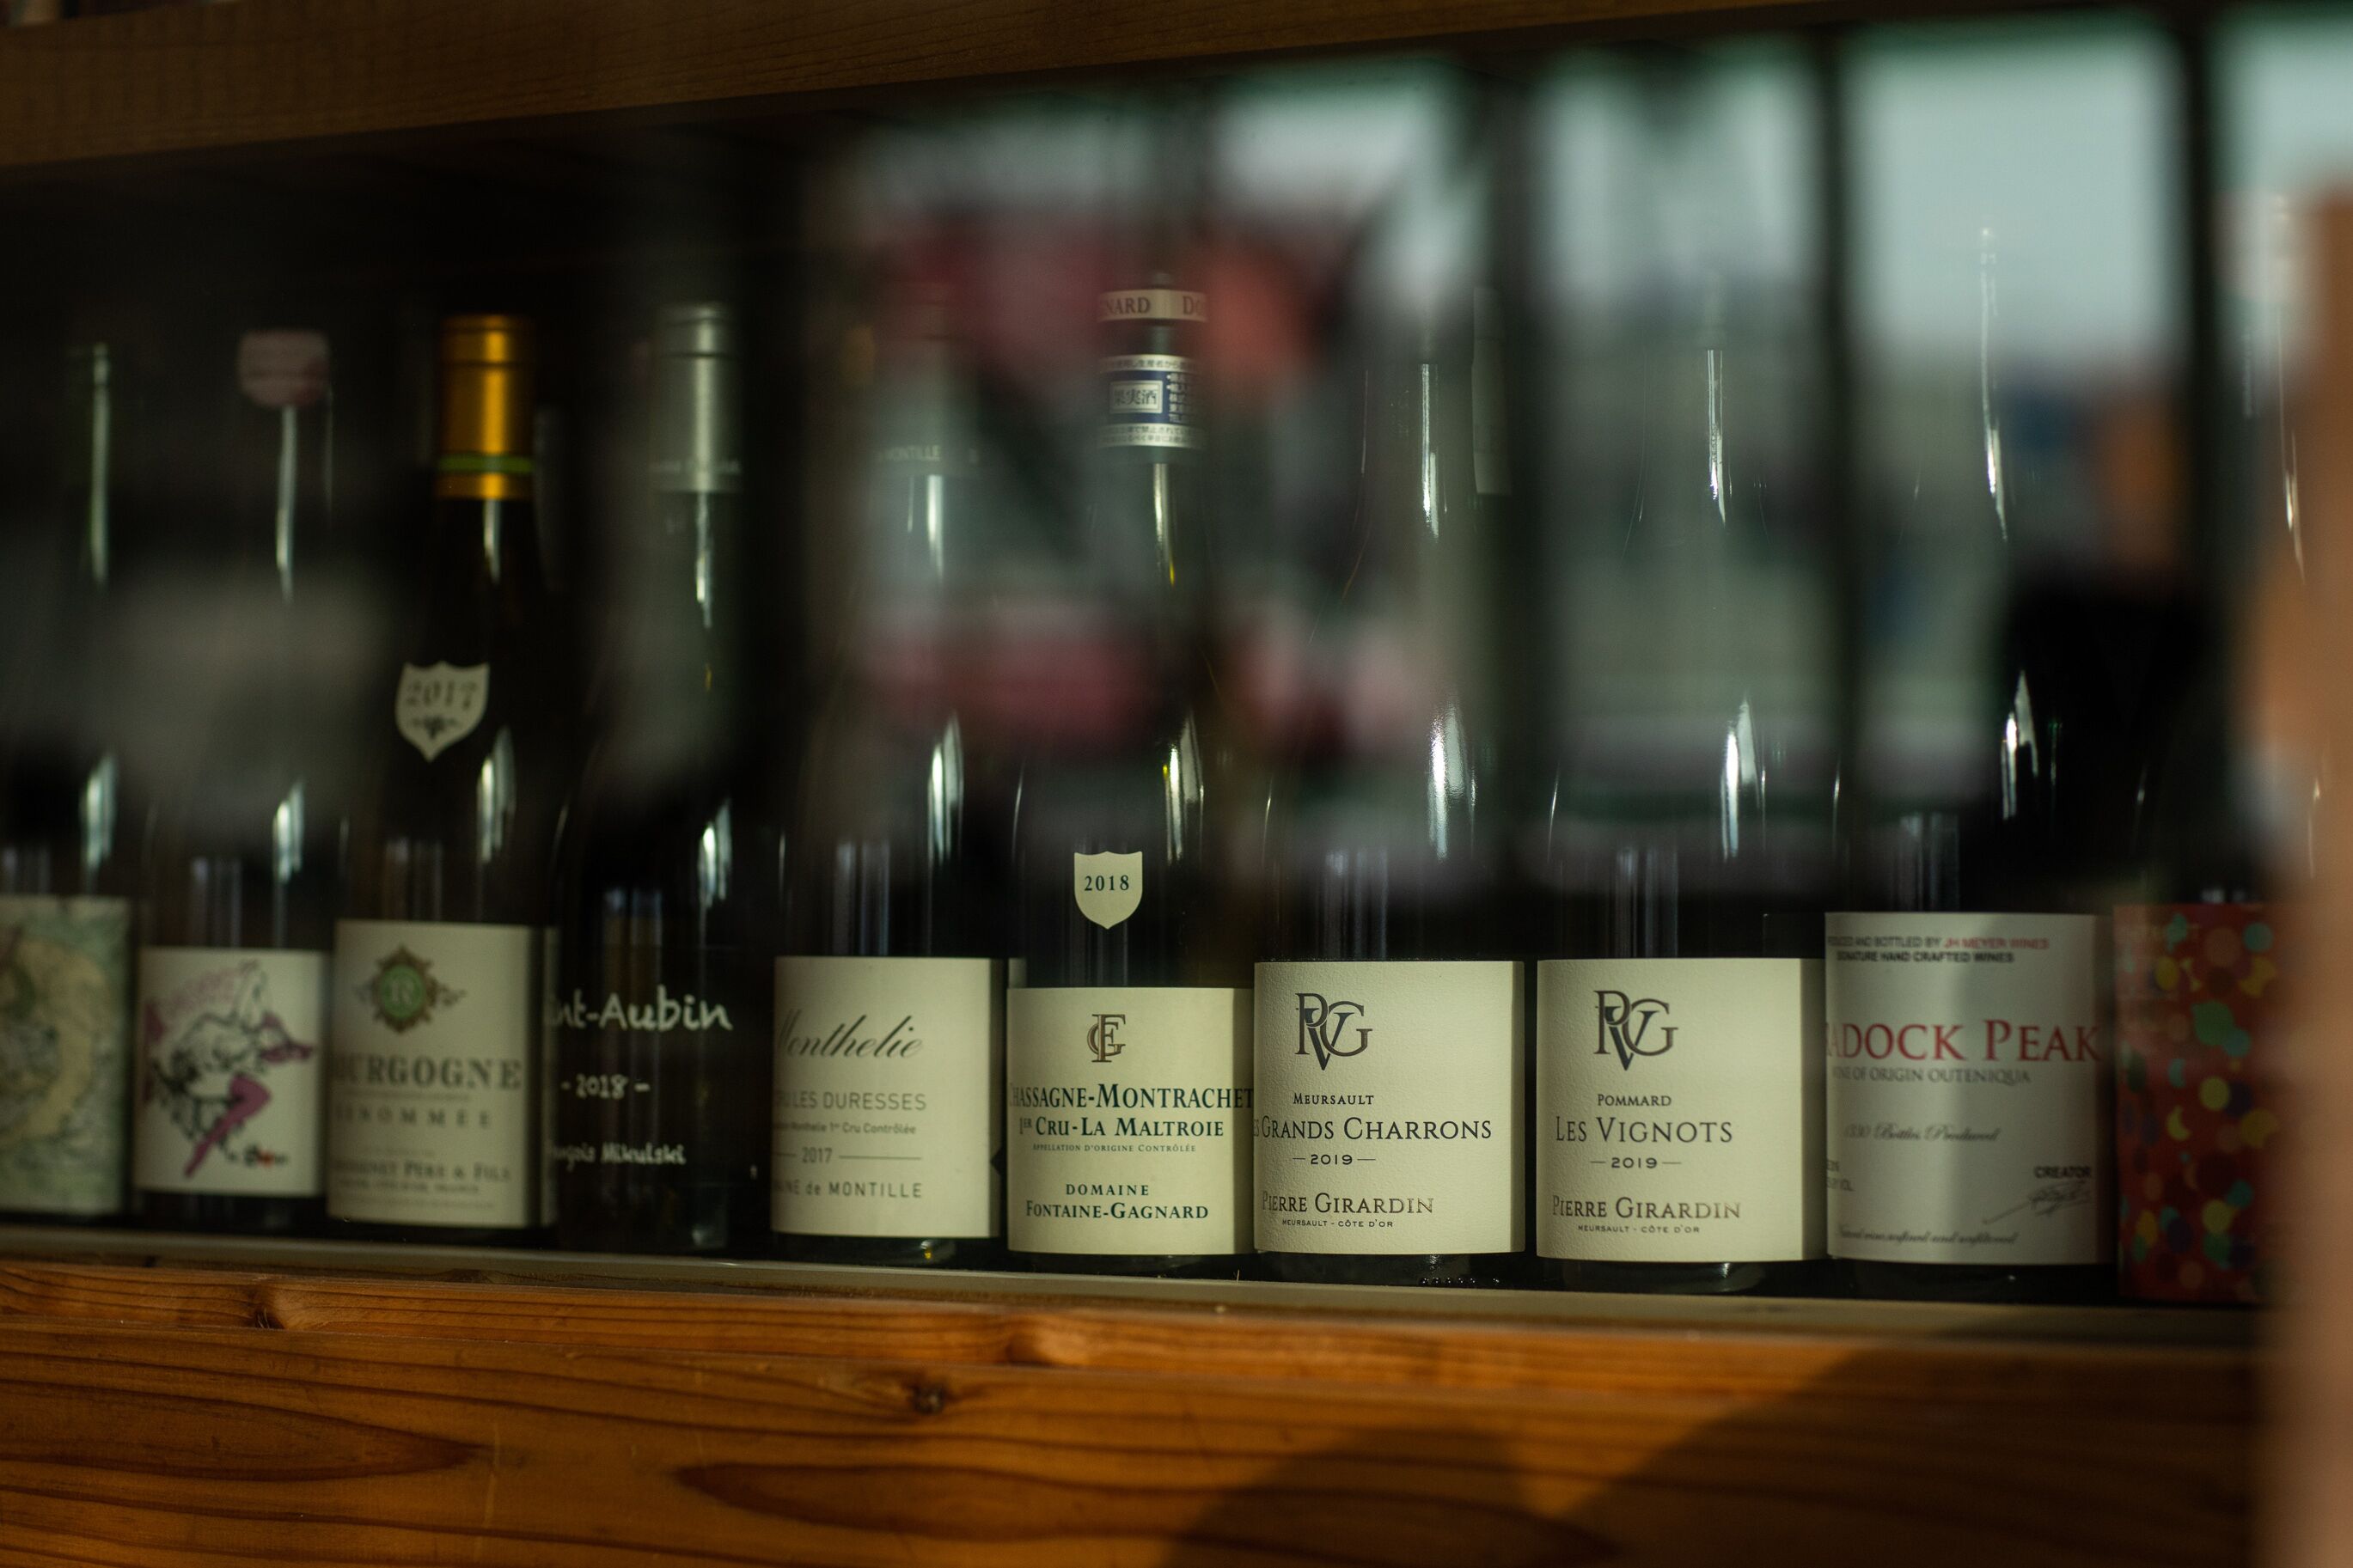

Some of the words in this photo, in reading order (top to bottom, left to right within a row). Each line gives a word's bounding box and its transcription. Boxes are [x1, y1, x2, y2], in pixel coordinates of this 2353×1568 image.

[1114, 388, 1157, 406] 果実酒
[406, 680, 478, 711] 2017
[1085, 875, 1129, 891] 2018
[1873, 936, 1922, 948] BOTTLED
[1923, 937, 1942, 948] BY
[1962, 937, 2008, 949] MEYER
[2009, 939, 2050, 950] WINES
[1880, 952, 1910, 962] HAND
[1913, 952, 1971, 962] CRAFTED
[1973, 953, 2015, 962] WINES
[1983, 1019, 2103, 1062] PEAK
[1868, 1067, 1924, 1082] ORIGIN
[1928, 1067, 2032, 1086] OUTENIQUA
[576, 1074, 628, 1100] 2018
[822, 1090, 927, 1111] DURESSES
[1293, 1092, 1374, 1106] MEURSAULT
[1597, 1094, 1672, 1107] POMMARD
[842, 1121, 861, 1133] Cru
[863, 1122, 917, 1135] Contrôlée
[1116, 1117, 1224, 1137] MALTROIE
[1262, 1115, 1335, 1140] GRANDS
[1343, 1116, 1493, 1140] CHARRONS
[1555, 1116, 1587, 1142] LES
[1596, 1117, 1733, 1144] VIGNOTS
[1923, 1122, 2002, 1141] Produced
[602, 1142, 687, 1165] Mikulski
[802, 1146, 833, 1164] 2017
[1033, 1143, 1080, 1152] APPELLATION
[1084, 1144, 1134, 1153] D'ORIGINE
[1138, 1143, 1197, 1153] CONTRÔLÉE
[1310, 1154, 1354, 1166] 2019
[1610, 1156, 1659, 1169] 2019
[2032, 1165, 2092, 1179] CREATOR
[805, 1181, 821, 1196] de
[828, 1181, 923, 1199] MONTILLE
[1066, 1184, 1149, 1196] DOMAINE
[1026, 1200, 1209, 1220] FONTAINE-GAGNARD
[1262, 1191, 1308, 1213] PIERRE
[1315, 1192, 1434, 1214] GIRARDIN
[1552, 1194, 1607, 1217] PIERRE
[1616, 1197, 1741, 1219] GIRARDIN
[1337, 1218, 1364, 1228] CÔTE
[1368, 1218, 1393, 1228] D'OR
[1578, 1224, 1629, 1234] MEURSAULT
[1640, 1224, 1669, 1235] CÔTE
[1673, 1224, 1701, 1235] D'OR
